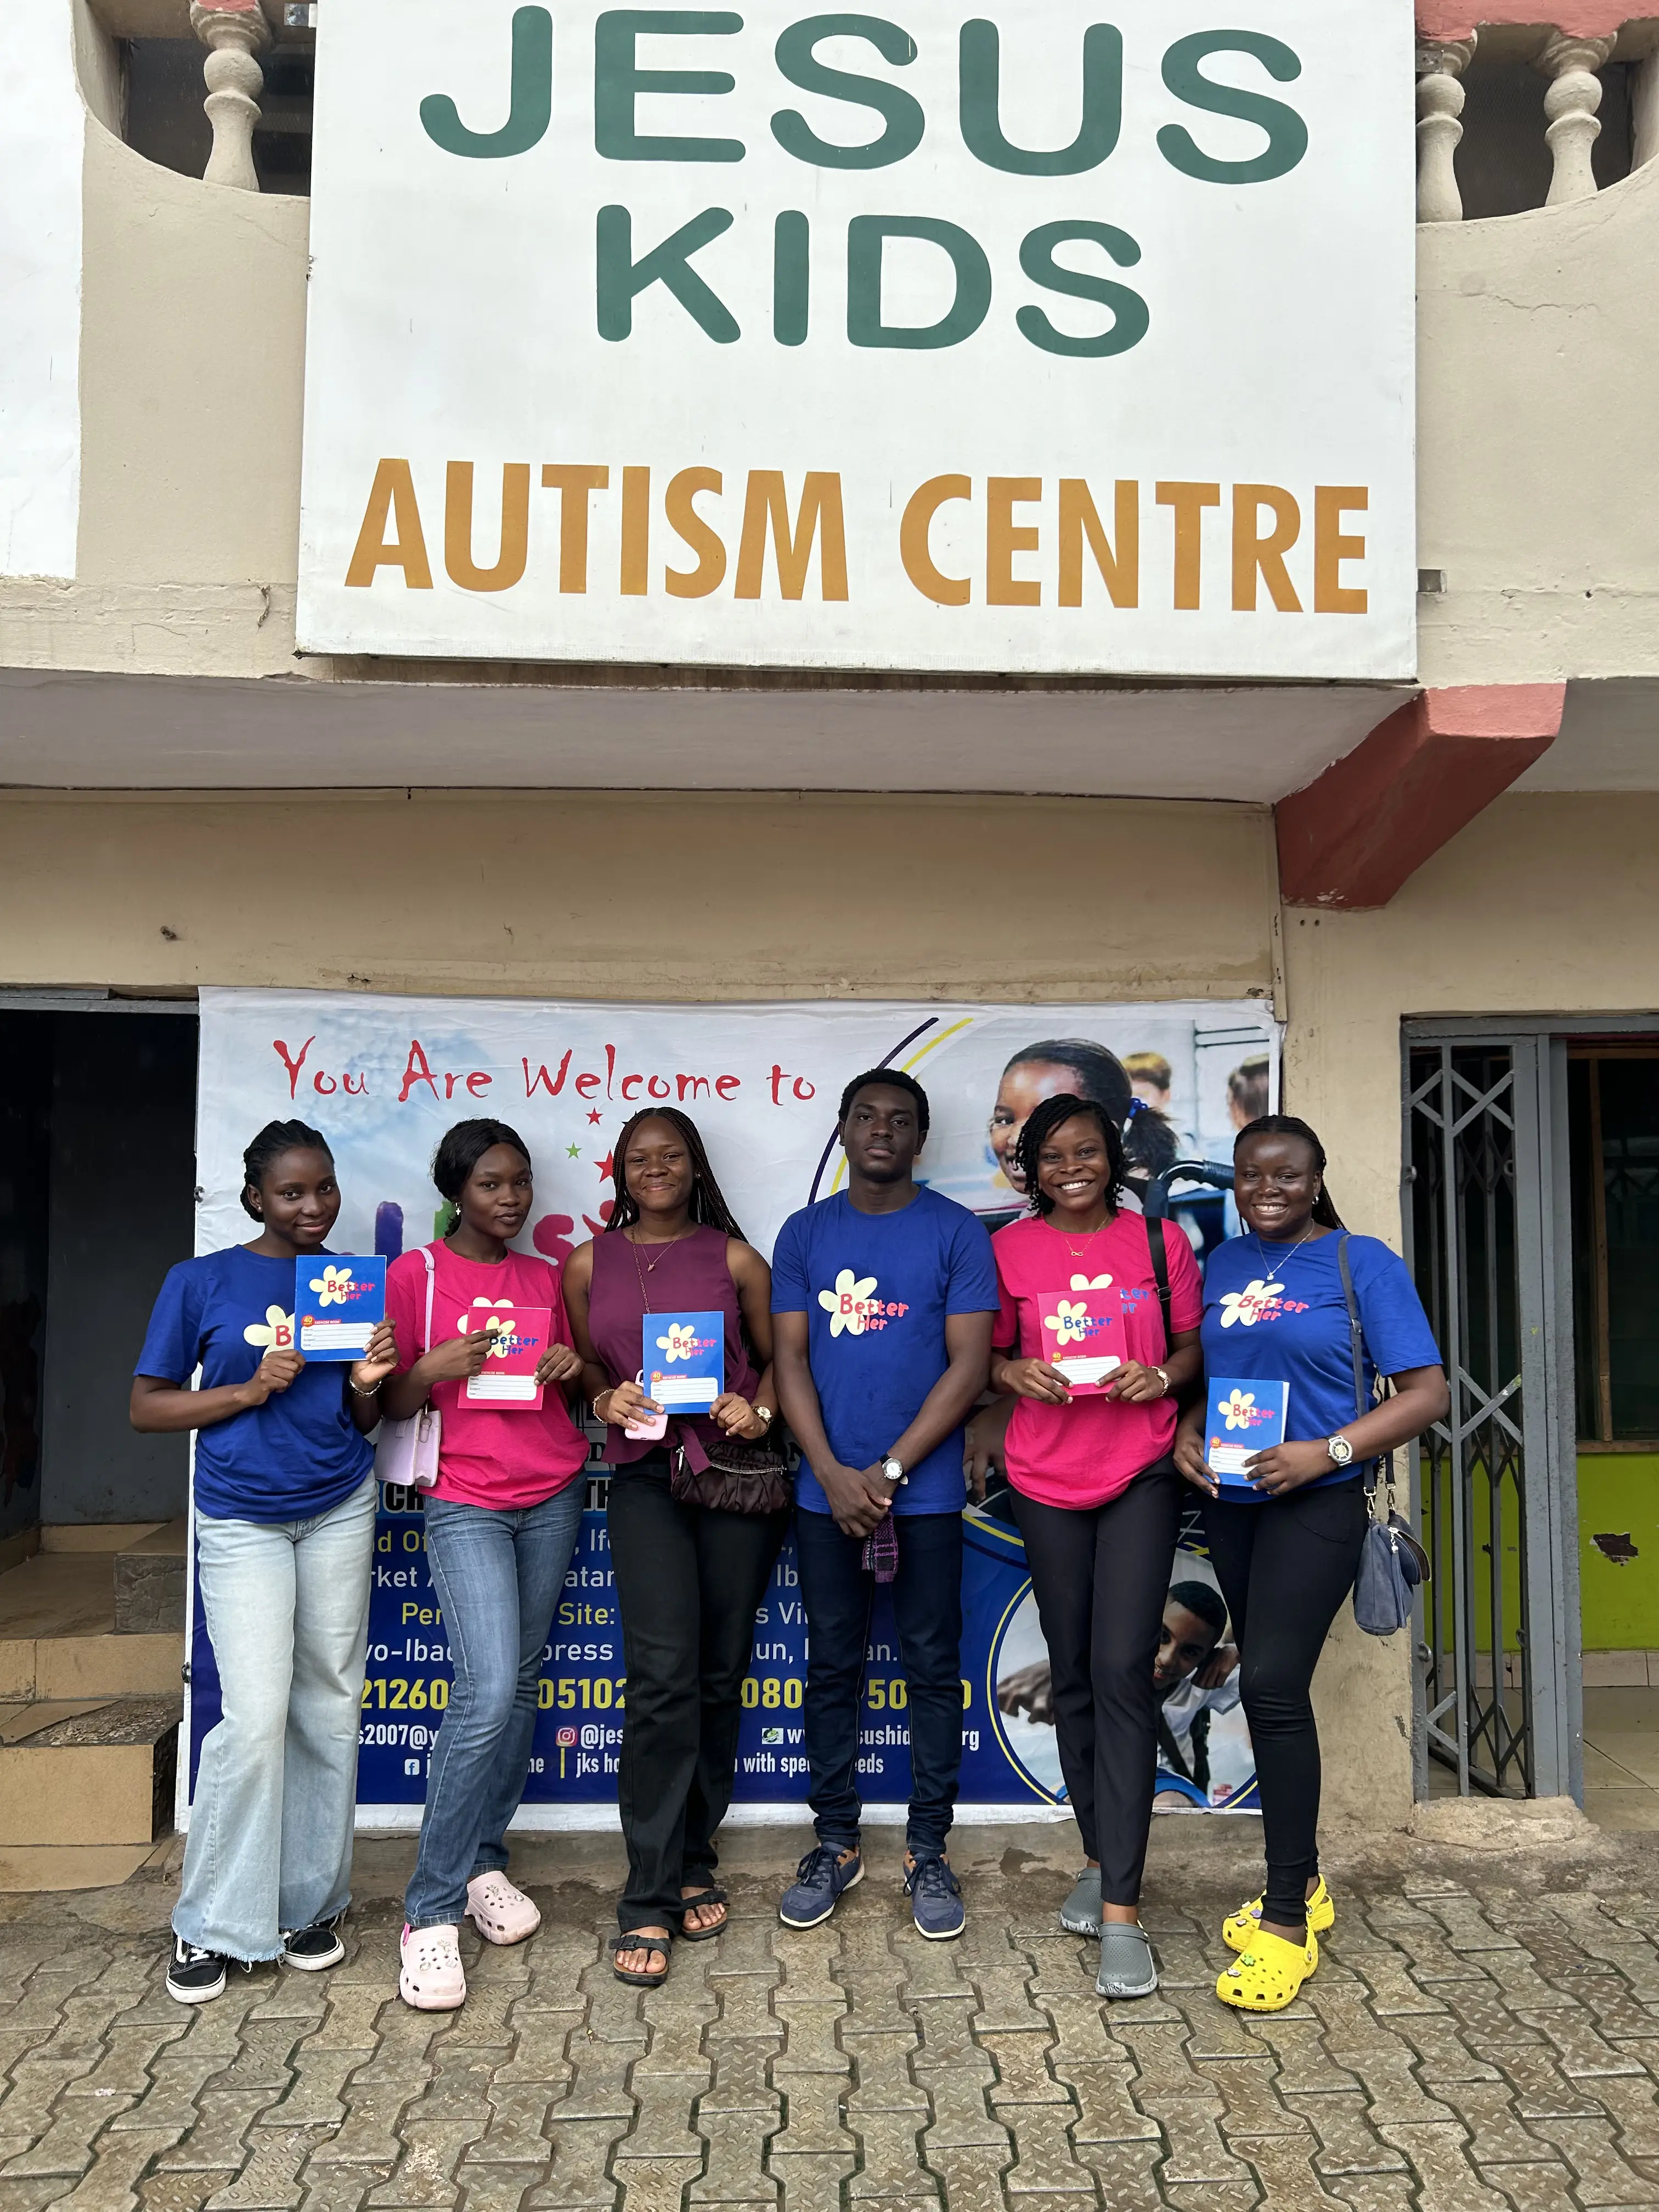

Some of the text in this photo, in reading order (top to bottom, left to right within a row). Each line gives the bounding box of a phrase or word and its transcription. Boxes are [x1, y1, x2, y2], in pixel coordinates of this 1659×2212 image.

[420, 6, 1309, 184] JESUS
[596, 204, 1150, 358] KIDS
[345, 458, 1368, 614] AUTISM CENTRE
[273, 1035, 815, 1105] You Are Welcome to
[328, 1280, 375, 1293] Better
[341, 1291, 362, 1301] Her
[1121, 1288, 1149, 1300] ter
[840, 1293, 909, 1317] Better
[1122, 1303, 1137, 1313] er
[1237, 1295, 1310, 1313] Better
[1249, 1308, 1282, 1322] Her
[857, 1315, 888, 1331] Her
[1063, 1316, 1113, 1329] Better
[1079, 1328, 1100, 1338] Her
[503, 1345, 523, 1355] Her
[673, 1337, 716, 1349] Better
[686, 1348, 705, 1357] Her
[1233, 1404, 1275, 1418] Better
[1244, 1416, 1263, 1426] Her
[558, 1602, 615, 1625] Site:
[575, 1752, 600, 1778] jks
[743, 1752, 776, 1773] with
